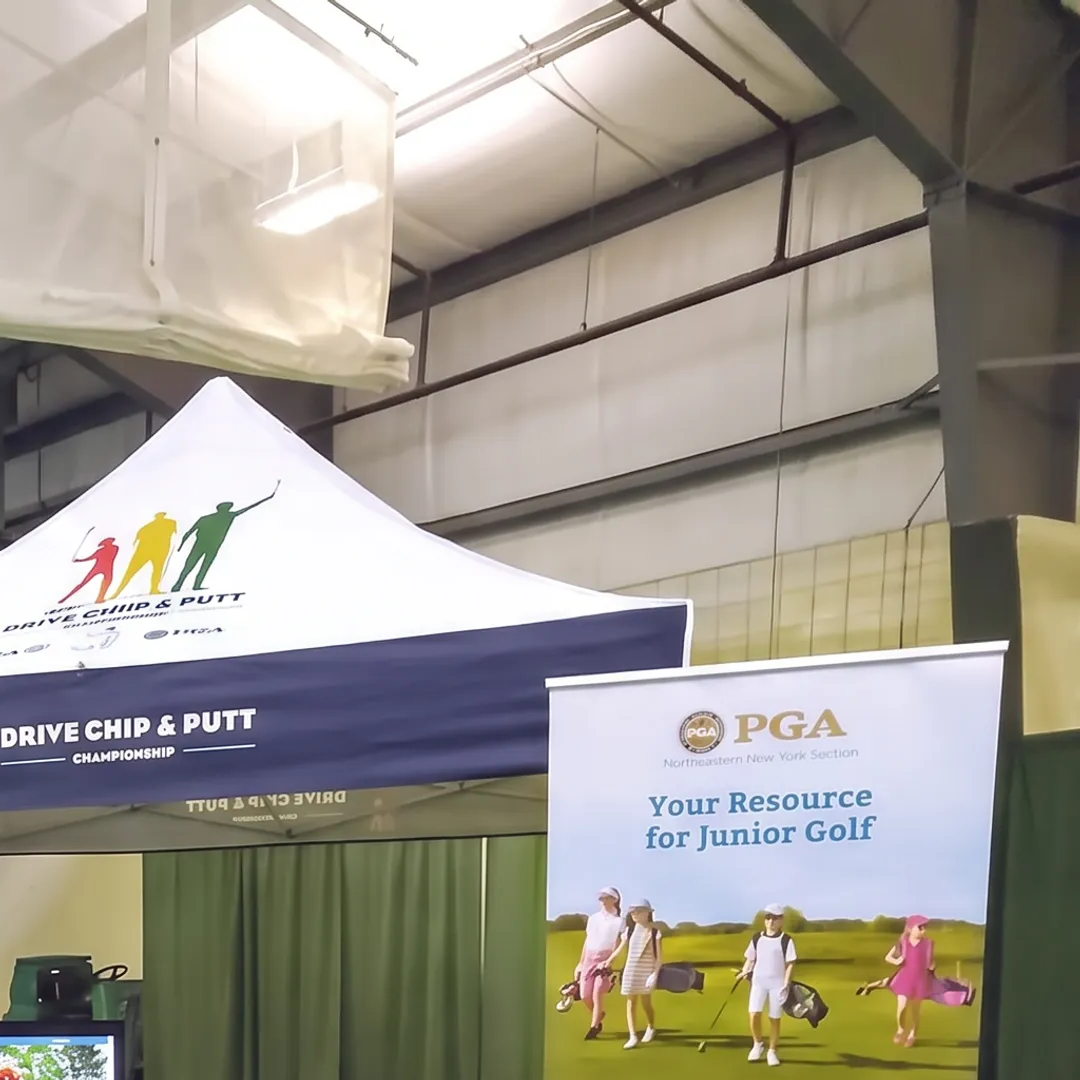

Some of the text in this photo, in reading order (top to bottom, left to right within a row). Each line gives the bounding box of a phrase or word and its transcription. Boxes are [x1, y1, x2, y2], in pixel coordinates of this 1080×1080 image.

[2, 613, 75, 633] DRIVE
[155, 599, 172, 609] &
[179, 592, 246, 607] PUTT
[0, 708, 258, 749] DRIVE CHIP & PUTT
[687, 727, 718, 738] PGA
[733, 709, 848, 744] PGA
[71, 746, 177, 765] CHAMPIONSHIP
[663, 748, 859, 768] Northeastern New York Section
[648, 789, 873, 817] Your Resource
[645, 816, 877, 852] for Junior Golf
